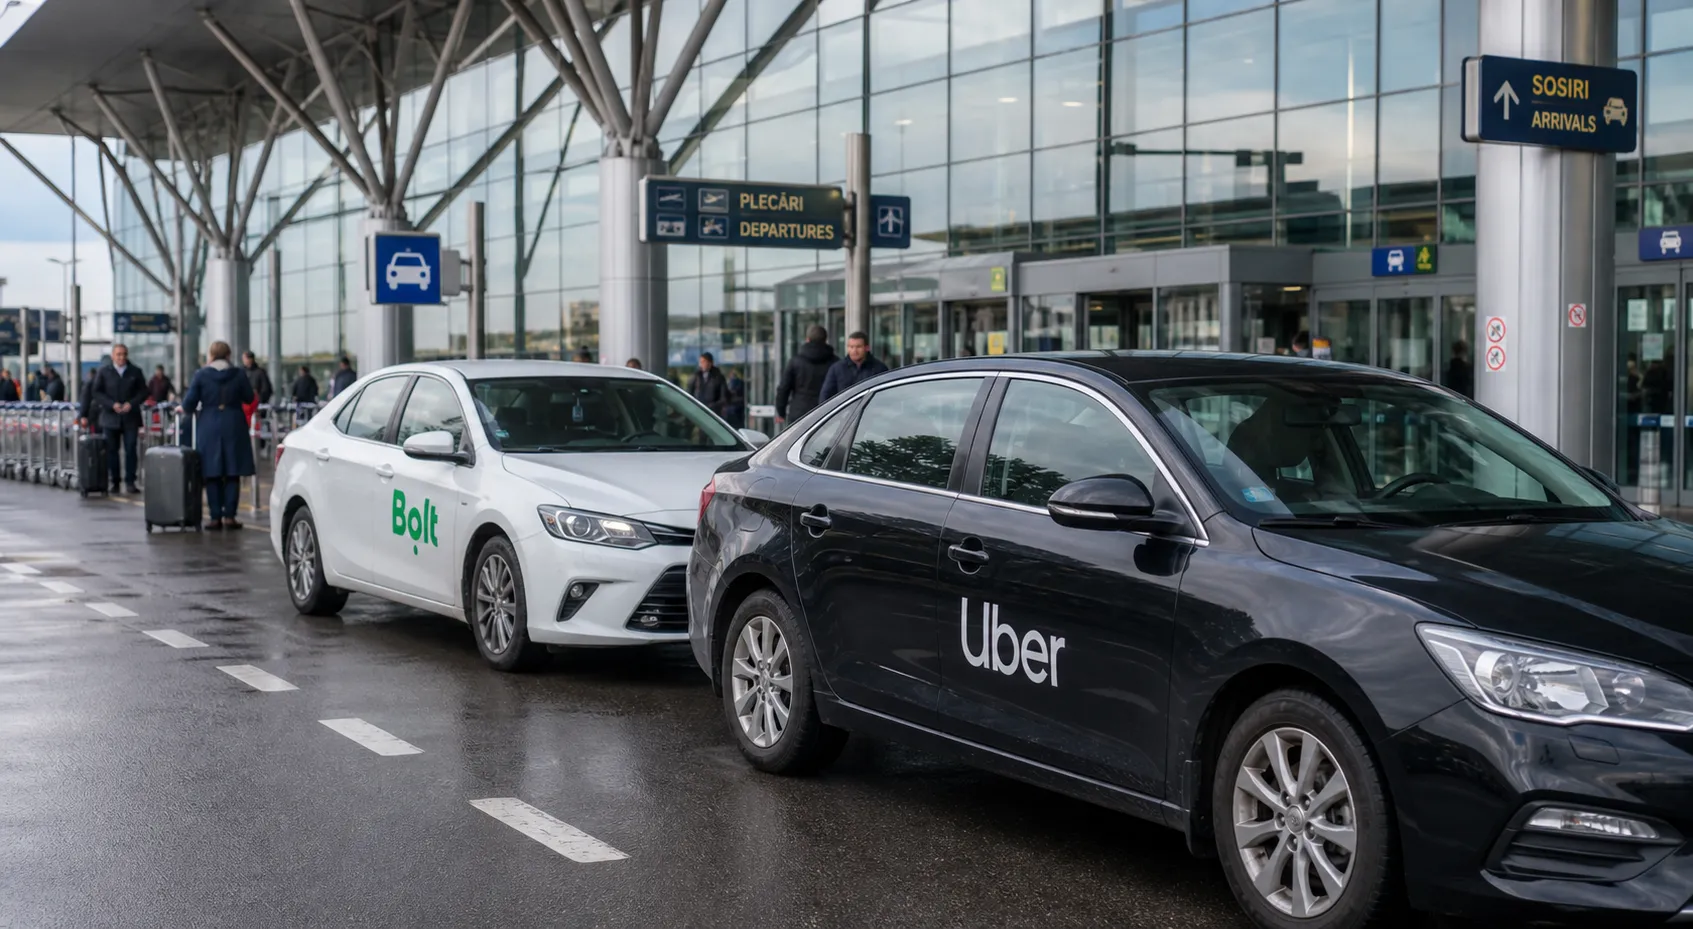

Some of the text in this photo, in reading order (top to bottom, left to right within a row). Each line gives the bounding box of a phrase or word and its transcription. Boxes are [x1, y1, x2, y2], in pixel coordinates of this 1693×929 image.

[1532, 74, 1589, 99] SOSIRI
[1531, 110, 1597, 132] ARRIVALS
[739, 221, 834, 239] DEPARTURES
[392, 488, 438, 555] Bolt
[961, 596, 1066, 687] Uber
